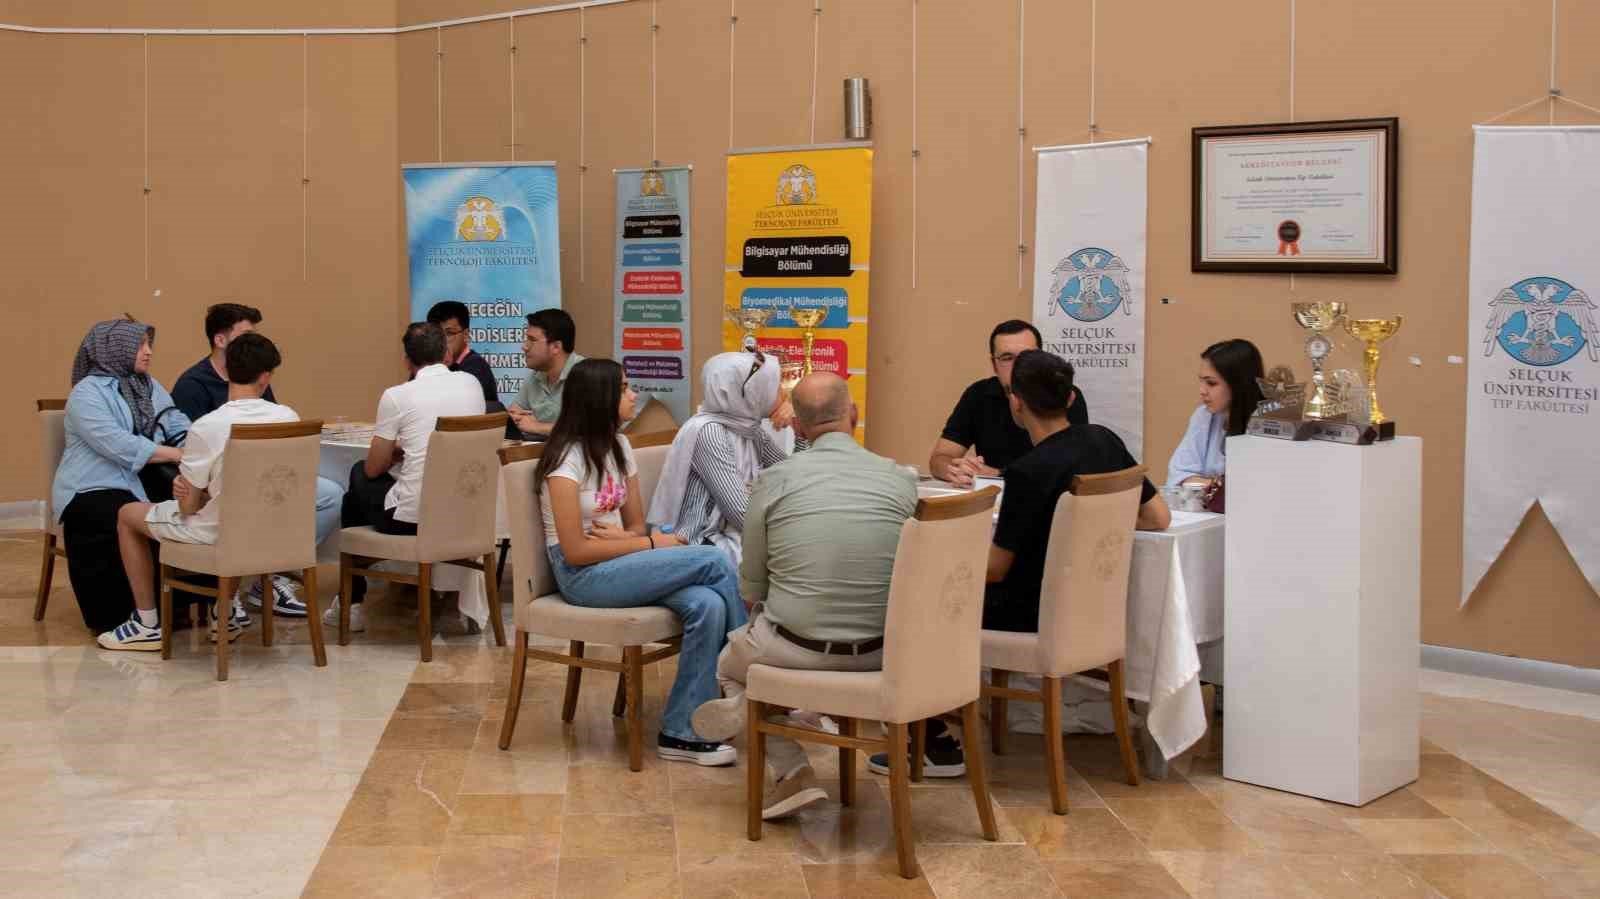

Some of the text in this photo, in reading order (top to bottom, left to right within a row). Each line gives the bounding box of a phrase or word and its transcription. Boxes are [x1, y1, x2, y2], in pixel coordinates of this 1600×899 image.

[745, 243, 849, 258] Bilgisayar Mühendisliği
[777, 260, 813, 270] Bölümü
[468, 298, 523, 318] ECEĞİN
[1061, 327, 1116, 341] SELÇUK
[1508, 368, 1573, 384] SELÇUK
[1483, 381, 1598, 401] ÜNİVERSİTESİ
[1492, 399, 1590, 415] TIP FAKÜLTESİ
